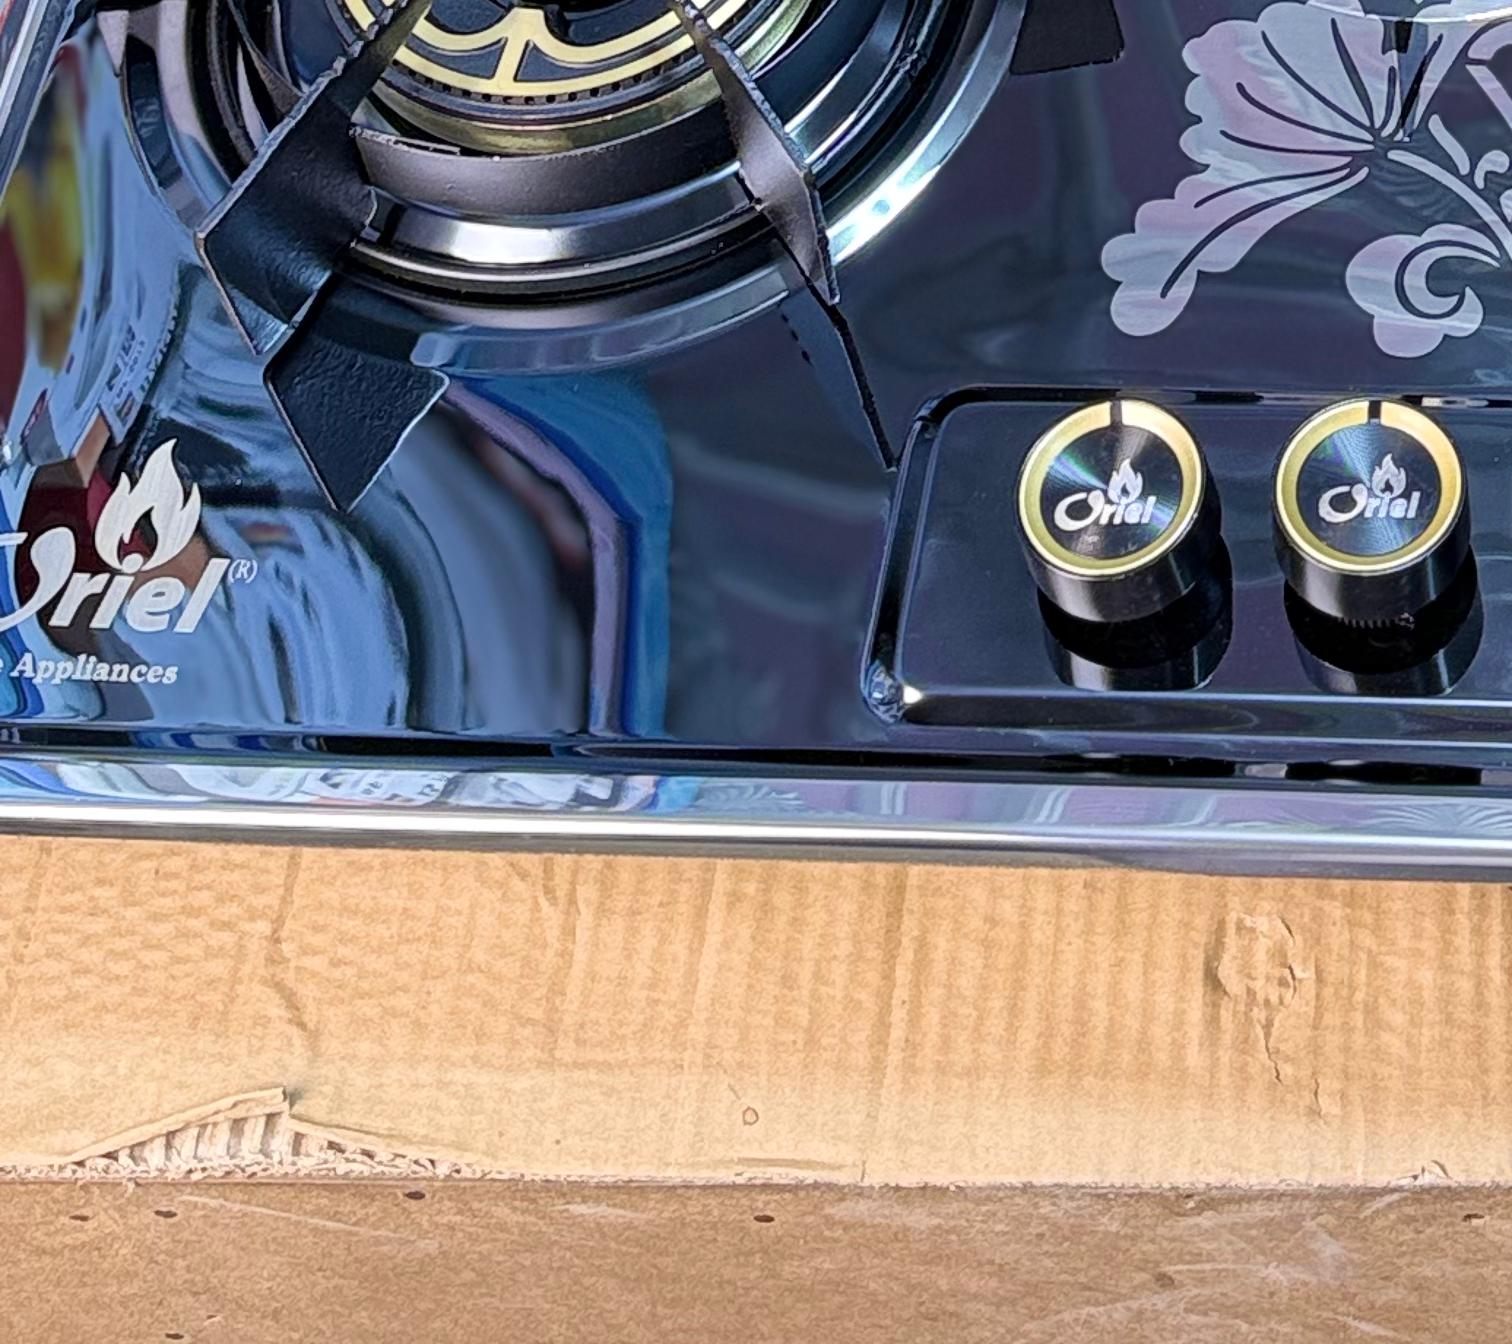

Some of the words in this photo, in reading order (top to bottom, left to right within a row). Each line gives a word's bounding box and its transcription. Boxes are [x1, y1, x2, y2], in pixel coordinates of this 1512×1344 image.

[1053, 489, 1157, 532] Oriel
[1318, 483, 1421, 524] Oriel
[10, 653, 178, 684] Appliances
